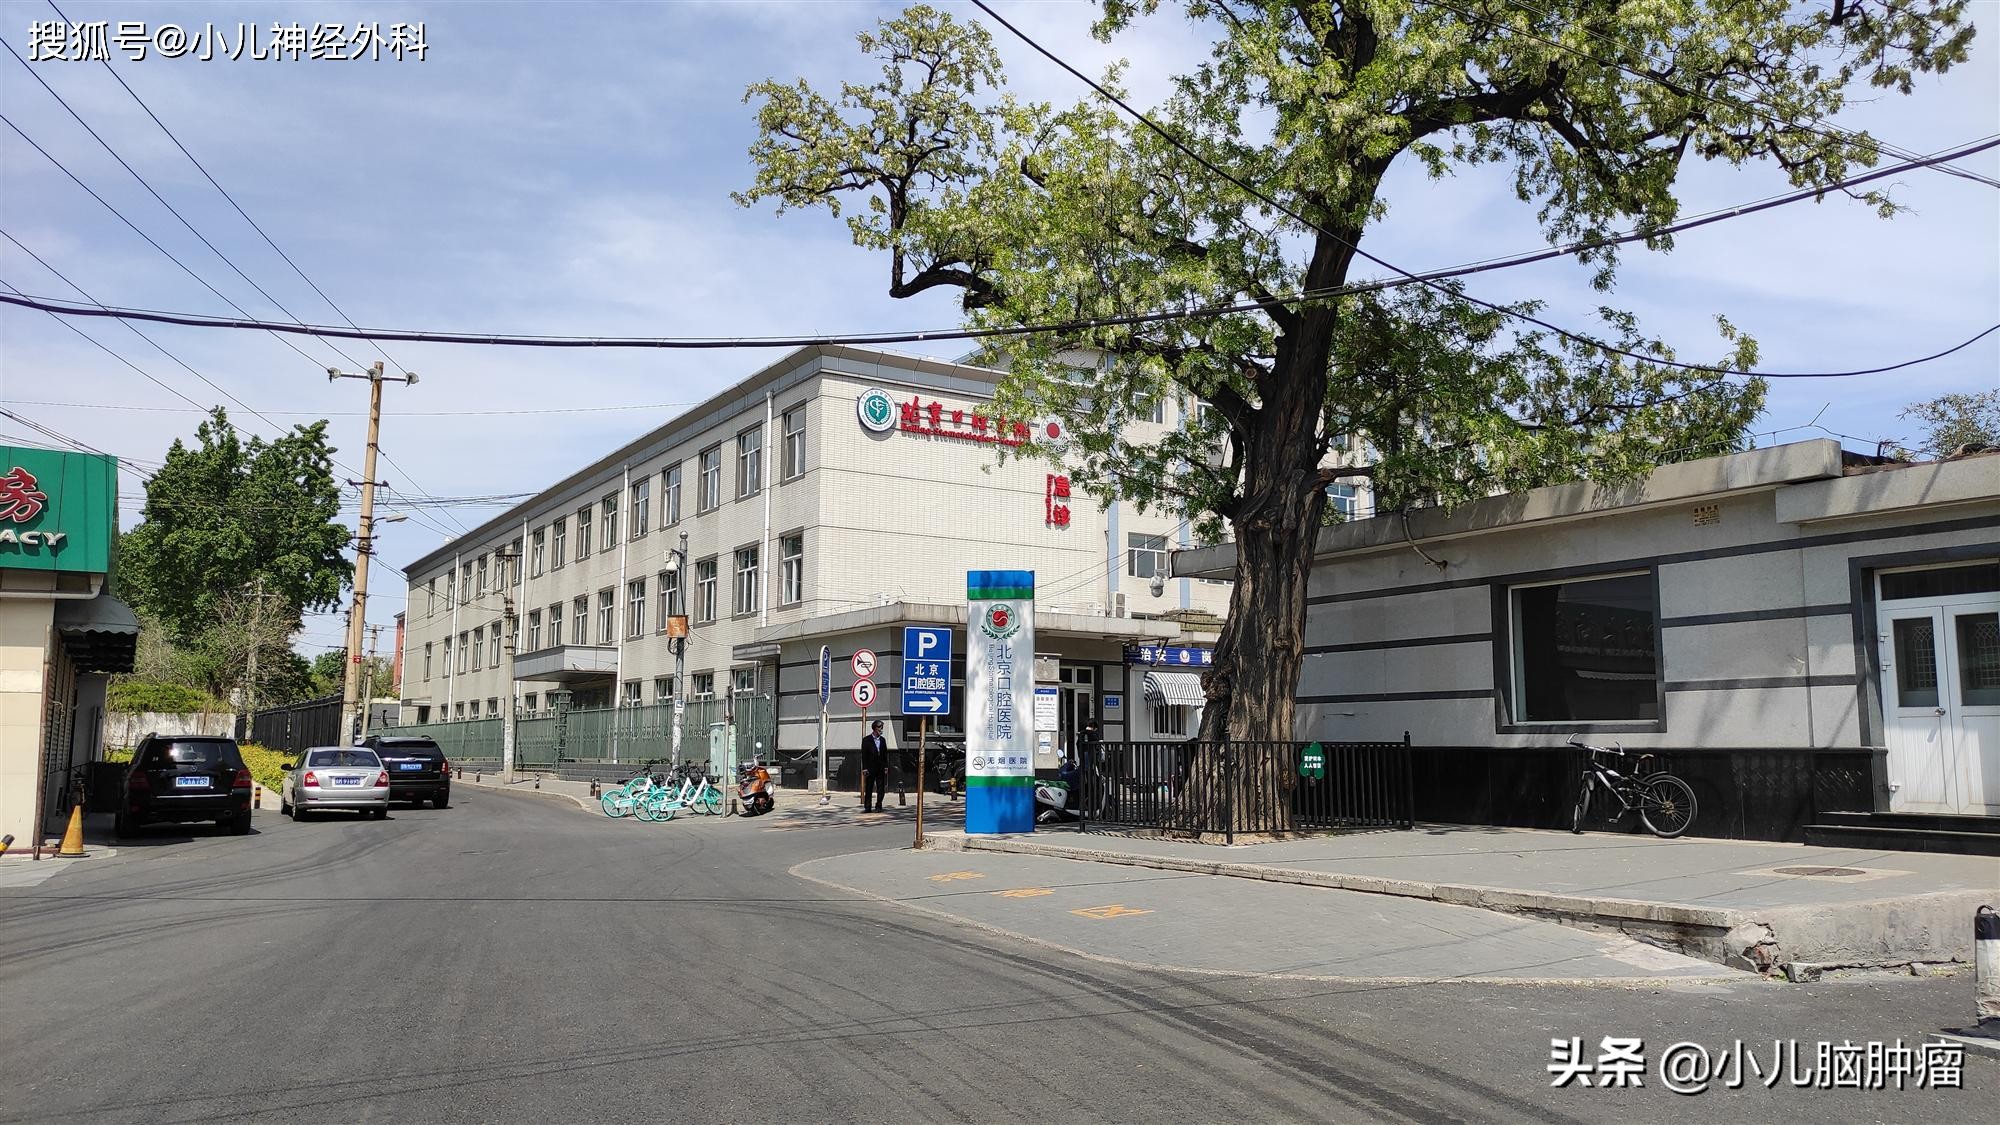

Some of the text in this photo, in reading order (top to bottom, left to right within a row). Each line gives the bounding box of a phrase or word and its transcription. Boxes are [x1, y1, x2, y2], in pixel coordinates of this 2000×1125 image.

[918, 632, 938, 658] P
[914, 663, 939, 676] 北京
[907, 676, 946, 691] 口腔医院
[996, 644, 1012, 740] 北京口腔医院
[859, 685, 869, 702] 5
